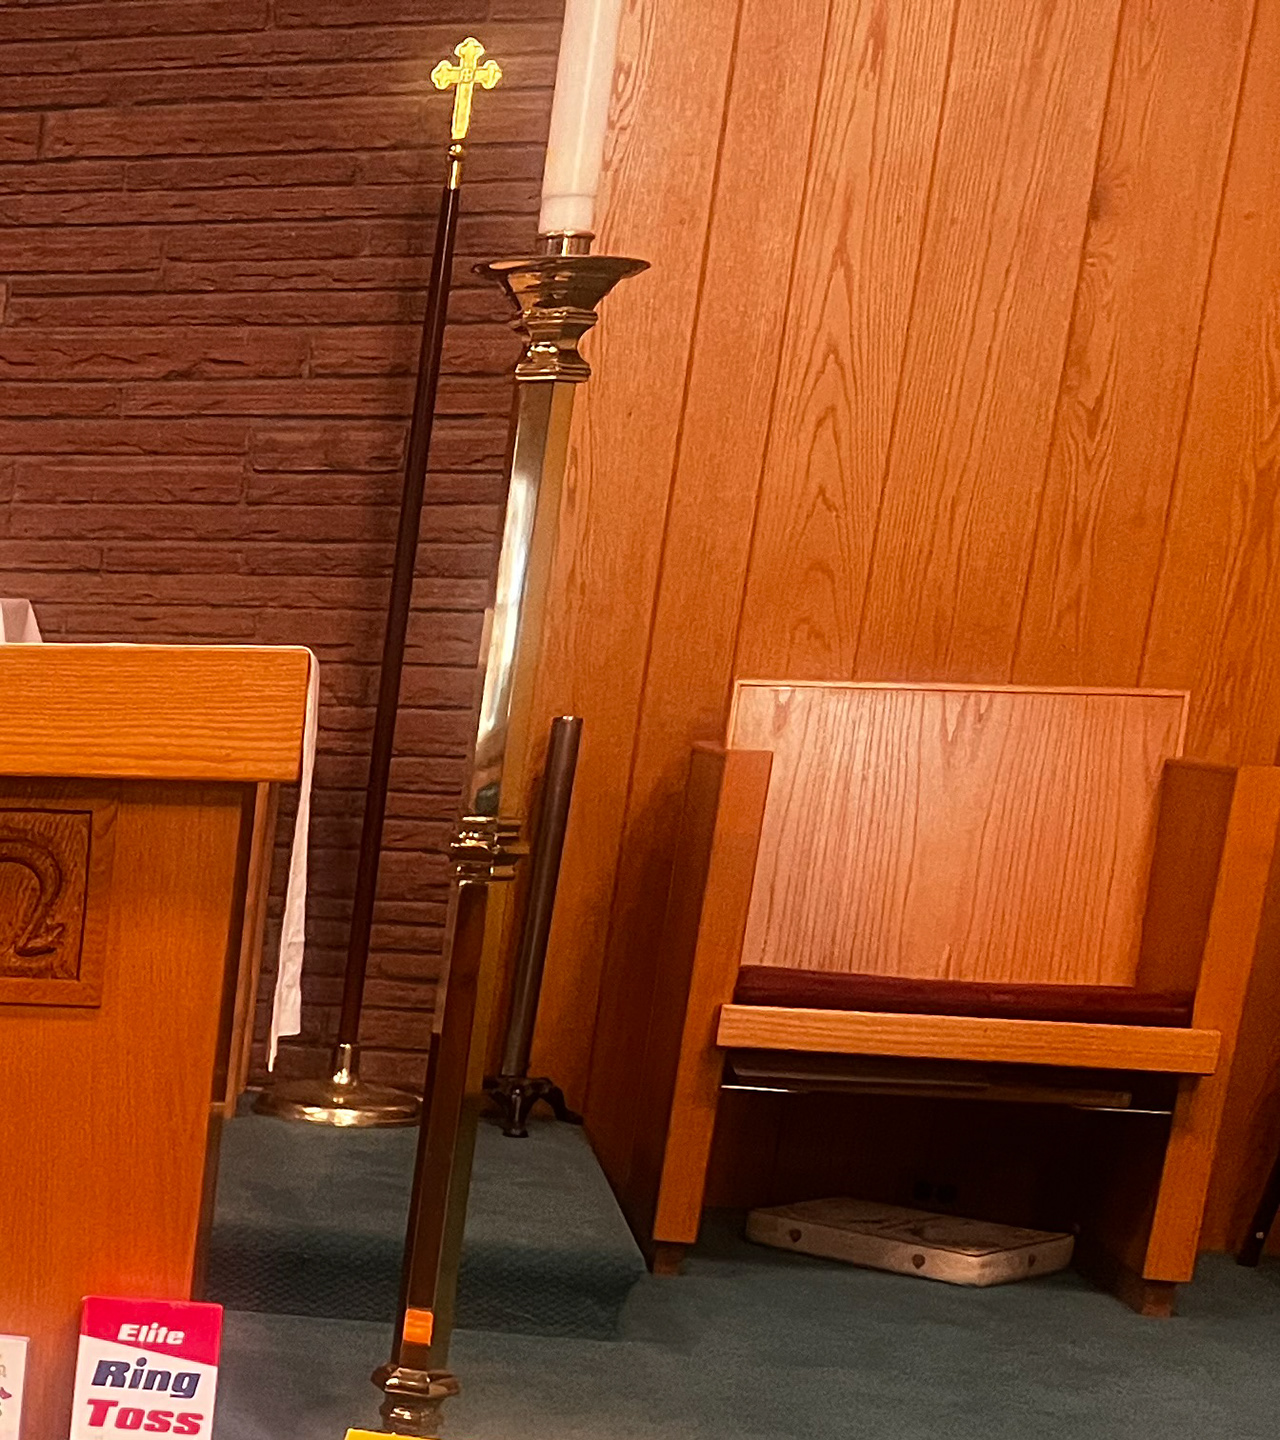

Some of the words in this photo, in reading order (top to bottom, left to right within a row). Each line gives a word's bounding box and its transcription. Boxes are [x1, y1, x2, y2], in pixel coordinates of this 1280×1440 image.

[117, 1322, 185, 1345] Elite
[91, 1356, 201, 1399] Ring
[87, 1399, 204, 1436] Toss
